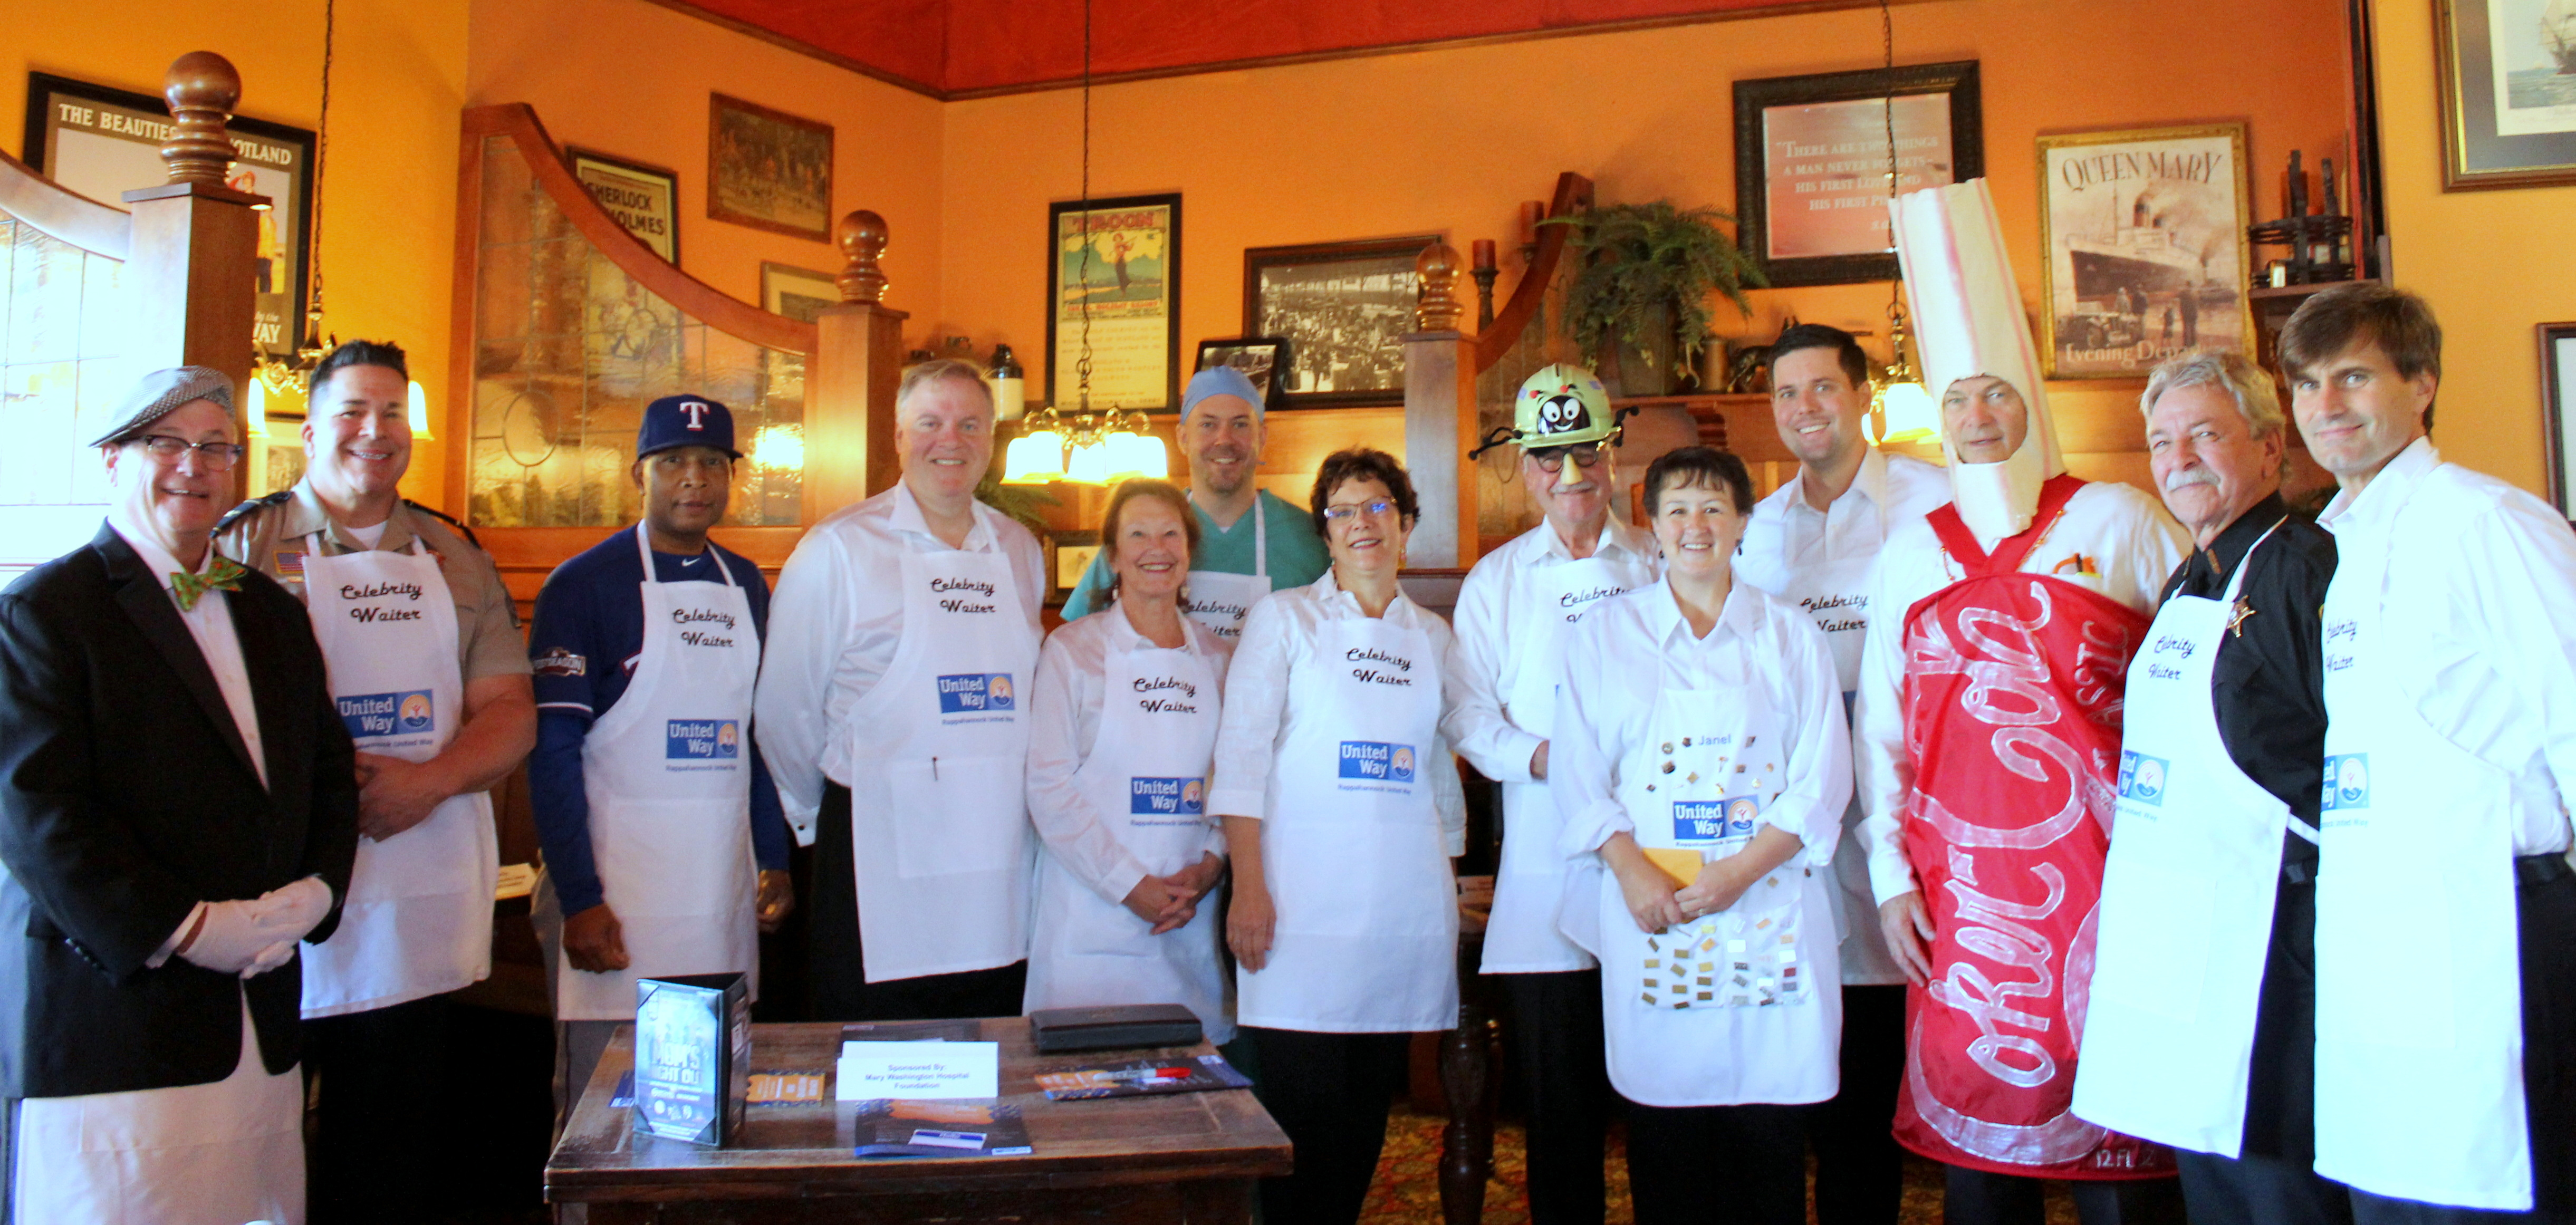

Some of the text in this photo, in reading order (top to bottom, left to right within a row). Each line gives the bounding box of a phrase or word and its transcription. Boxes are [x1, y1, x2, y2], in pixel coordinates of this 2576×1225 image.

[59, 103, 93, 126] THE
[2062, 151, 2222, 192] QUEEN MARY
[1796, 182, 1816, 192] HIS
[1820, 178, 1853, 191] FIRST
[1810, 198, 1830, 210] HIS
[1834, 195, 1867, 208] FIRST
[680, 401, 710, 431] T
[340, 582, 423, 600] Celebrity
[930, 577, 995, 596] Celebrity
[351, 607, 422, 623] Waiter
[940, 599, 996, 613] Waiter
[672, 608, 735, 630] Celebrity
[681, 632, 734, 647] Waiter
[1344, 648, 1412, 671] Celebrity
[939, 677, 985, 694] United
[1132, 676, 1196, 697] Celebrity
[1352, 669, 1412, 687] Waiter
[339, 697, 395, 717] United
[959, 692, 986, 709] Way
[1140, 700, 1197, 714] Waiter
[361, 715, 395, 735] Way
[669, 722, 714, 738] United
[688, 739, 714, 757] Way
[1341, 745, 1388, 760] United
[1359, 759, 1388, 778] Way
[1133, 780, 1178, 795] United
[1151, 795, 1179, 813] Way
[1675, 802, 1723, 819] United
[1694, 819, 1723, 837] Way
